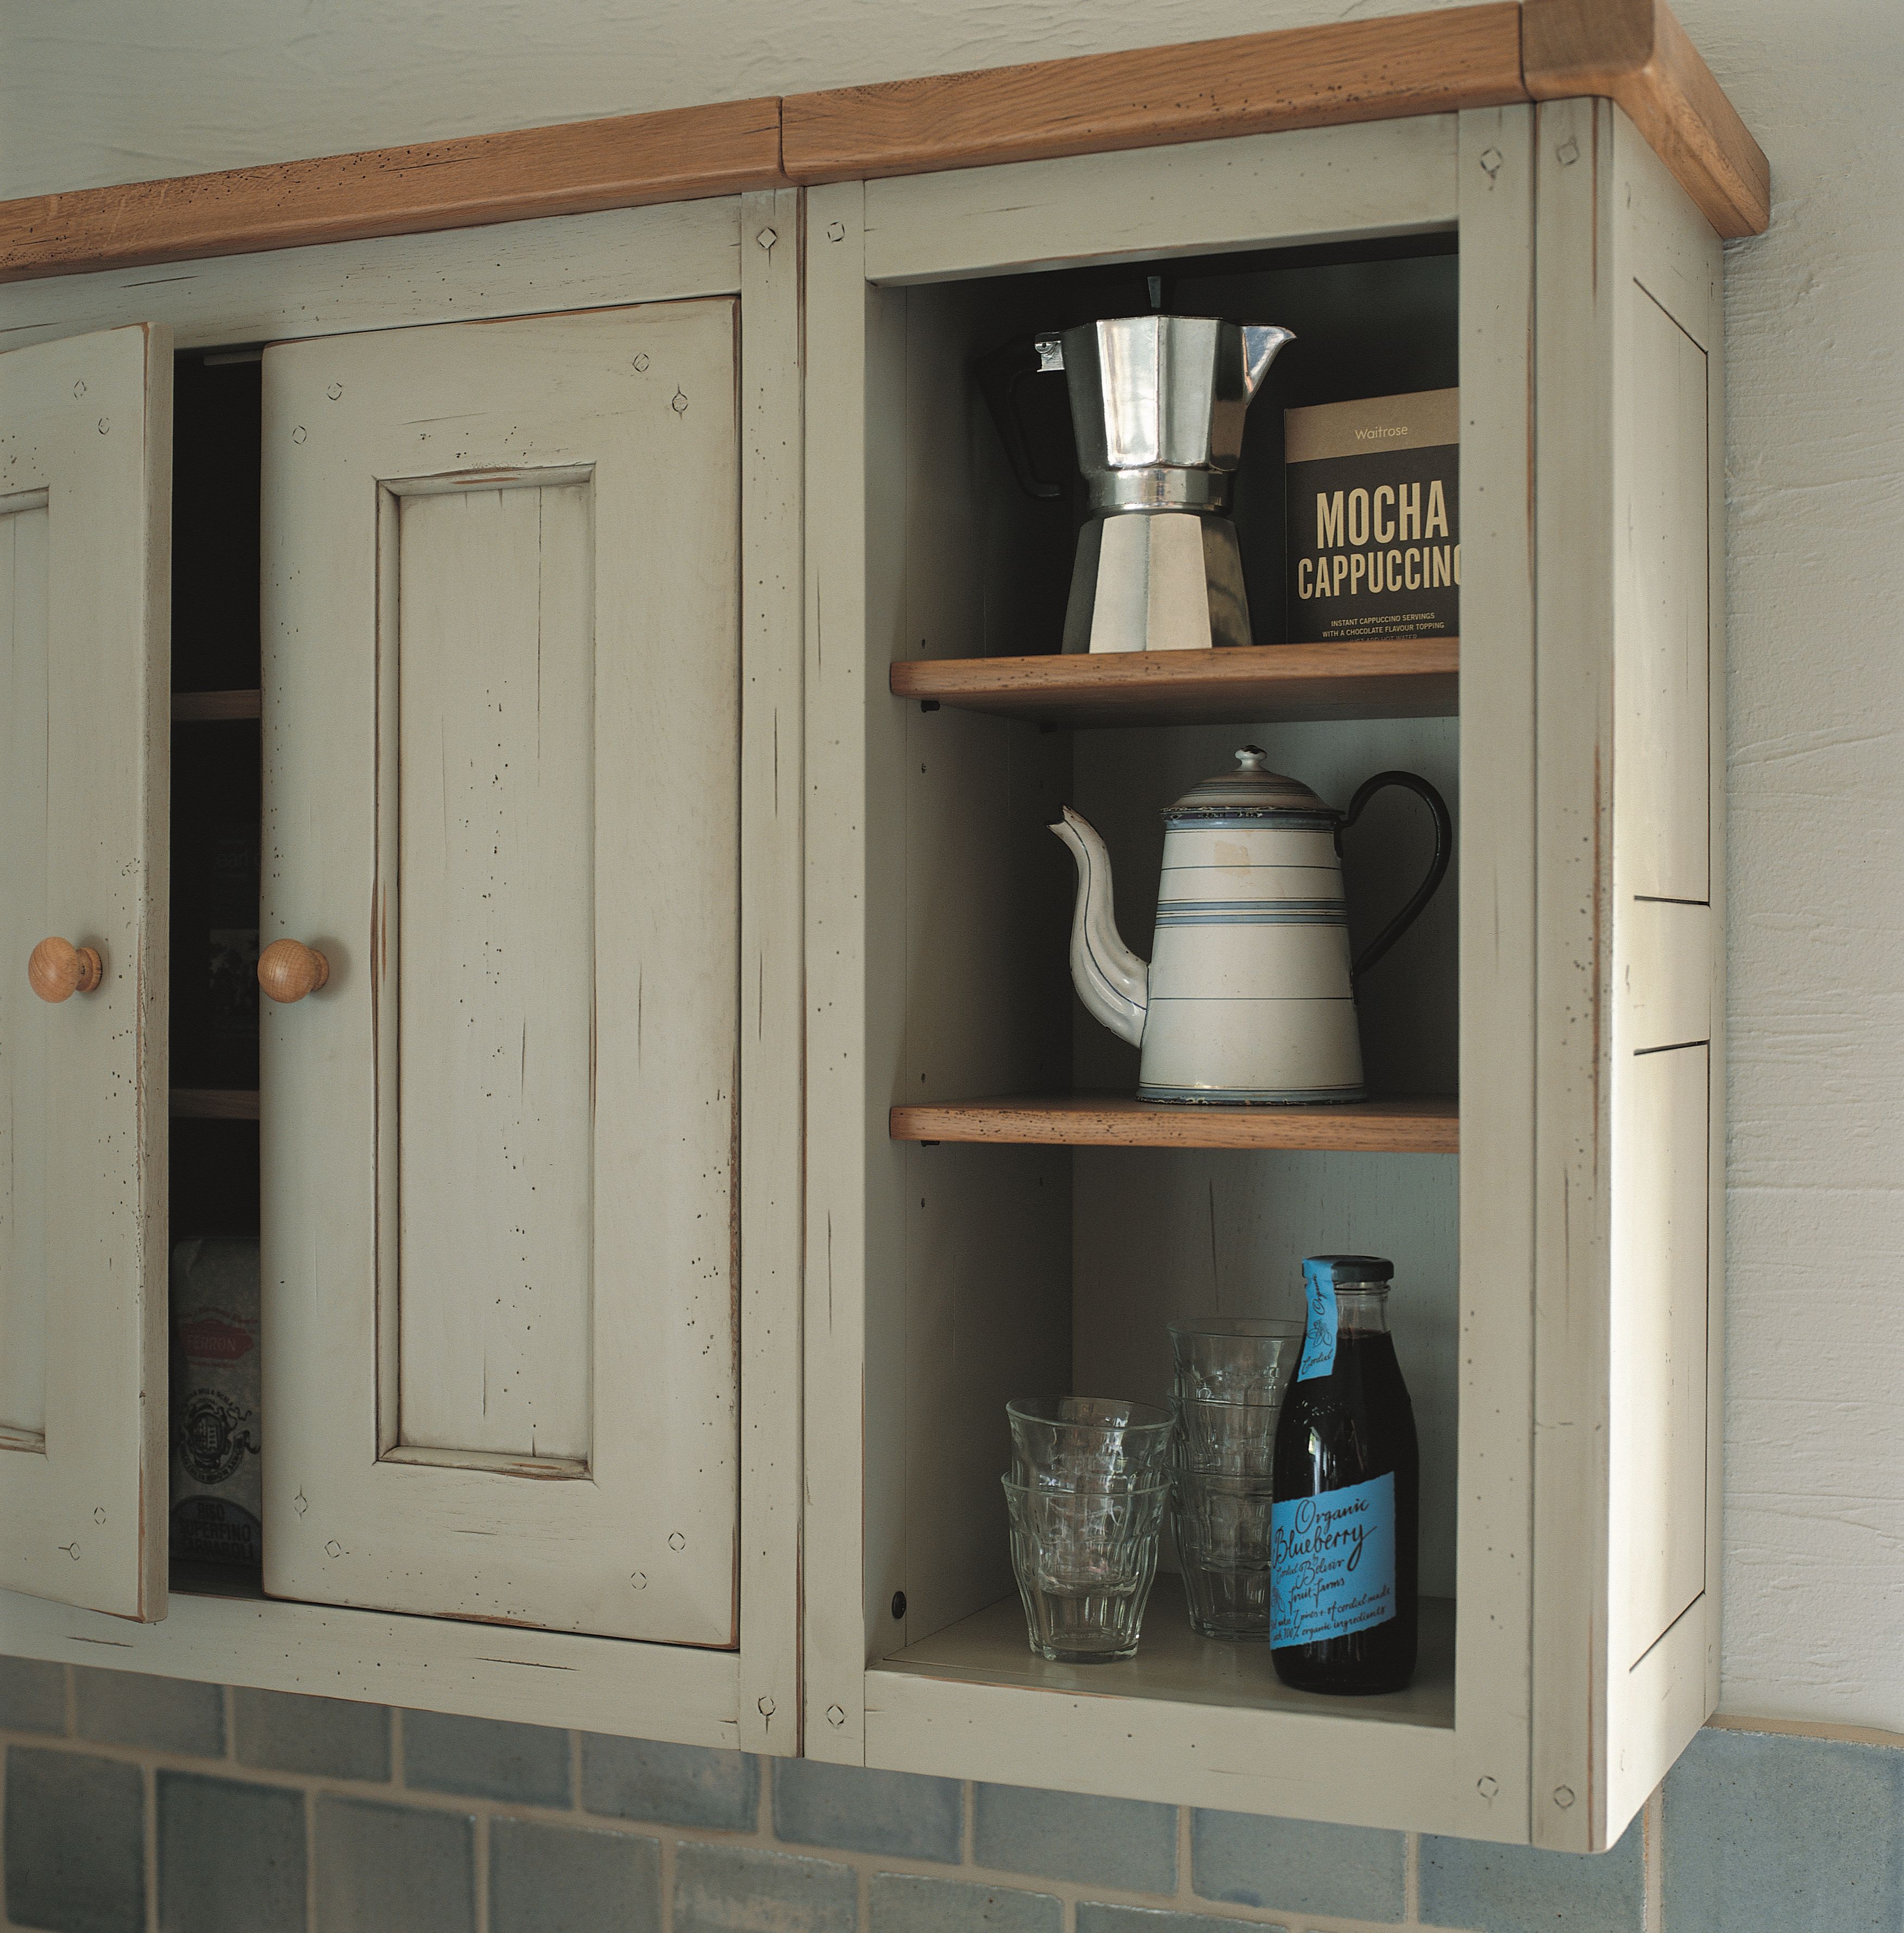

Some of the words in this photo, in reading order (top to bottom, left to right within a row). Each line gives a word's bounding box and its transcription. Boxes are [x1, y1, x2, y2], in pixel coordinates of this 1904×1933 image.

[1355, 425, 1408, 440] Waitrose
[1316, 480, 1449, 549] MOCHA
[1322, 630, 1339, 638] WITH
[1346, 626, 1383, 636] CHOCOLATE
[1385, 624, 1414, 632] FLAVOUR
[1416, 622, 1445, 630] TOPPING
[1331, 618, 1358, 627] INSTANT
[1359, 615, 1400, 625] CAPPUCCINO
[1402, 612, 1435, 621] SERVINGS
[187, 1335, 236, 1352] FERRON
[1301, 1348, 1334, 1375] Cordial
[1295, 1498, 1370, 1534] Organic
[1273, 1523, 1378, 1572] Blueberry
[1313, 1577, 1345, 1609] farms
